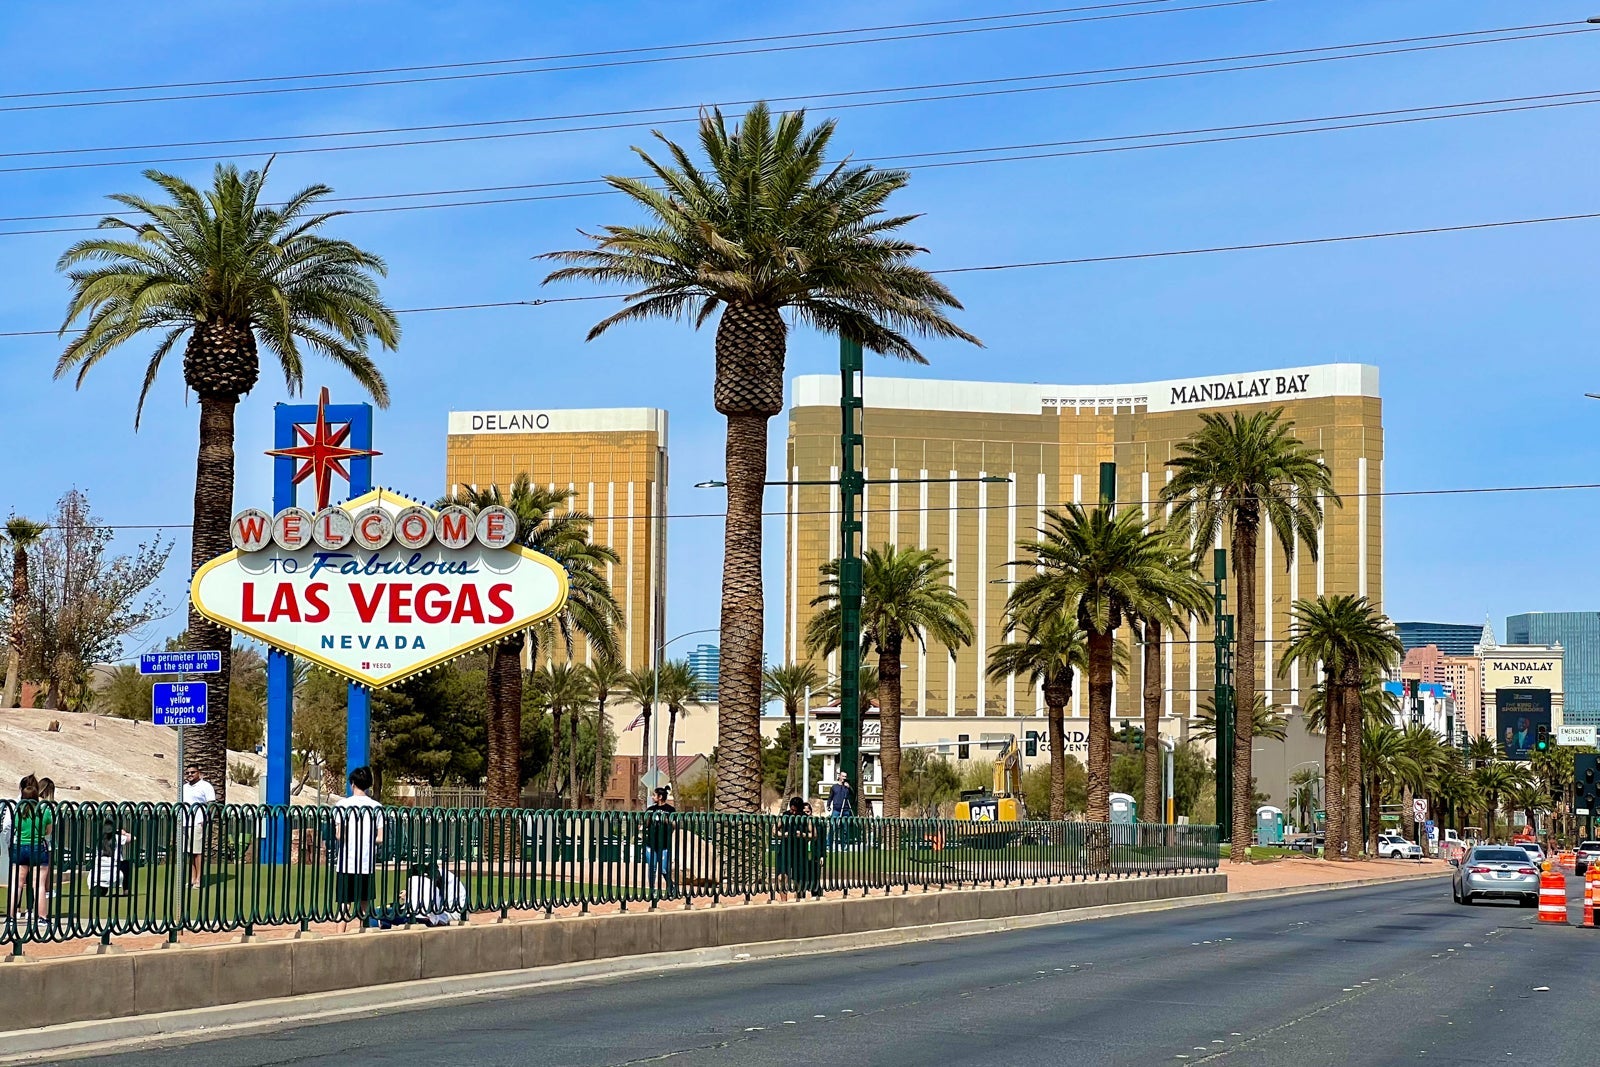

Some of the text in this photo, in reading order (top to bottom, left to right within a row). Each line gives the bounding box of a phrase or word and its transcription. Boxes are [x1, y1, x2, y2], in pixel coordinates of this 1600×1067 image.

[1170, 374, 1310, 404] MANDALAY BAY
[472, 413, 550, 430] DELANO
[237, 513, 506, 545] WELCOME
[269, 552, 480, 579] TO Fabulous
[241, 582, 515, 624] LAS VEGAS
[321, 634, 426, 650] NEVADA
[142, 652, 219, 665] The perimeter lights
[164, 662, 176, 671] the
[178, 662, 194, 671] sign
[196, 662, 208, 670] are
[1493, 662, 1554, 671] MANDALAY
[1513, 675, 1533, 685] BAY
[171, 684, 189, 692] blue
[170, 696, 191, 706] yellow
[155, 705, 205, 716] in support of
[164, 715, 196, 724] Ukraine
[971, 805, 996, 821] CAT
